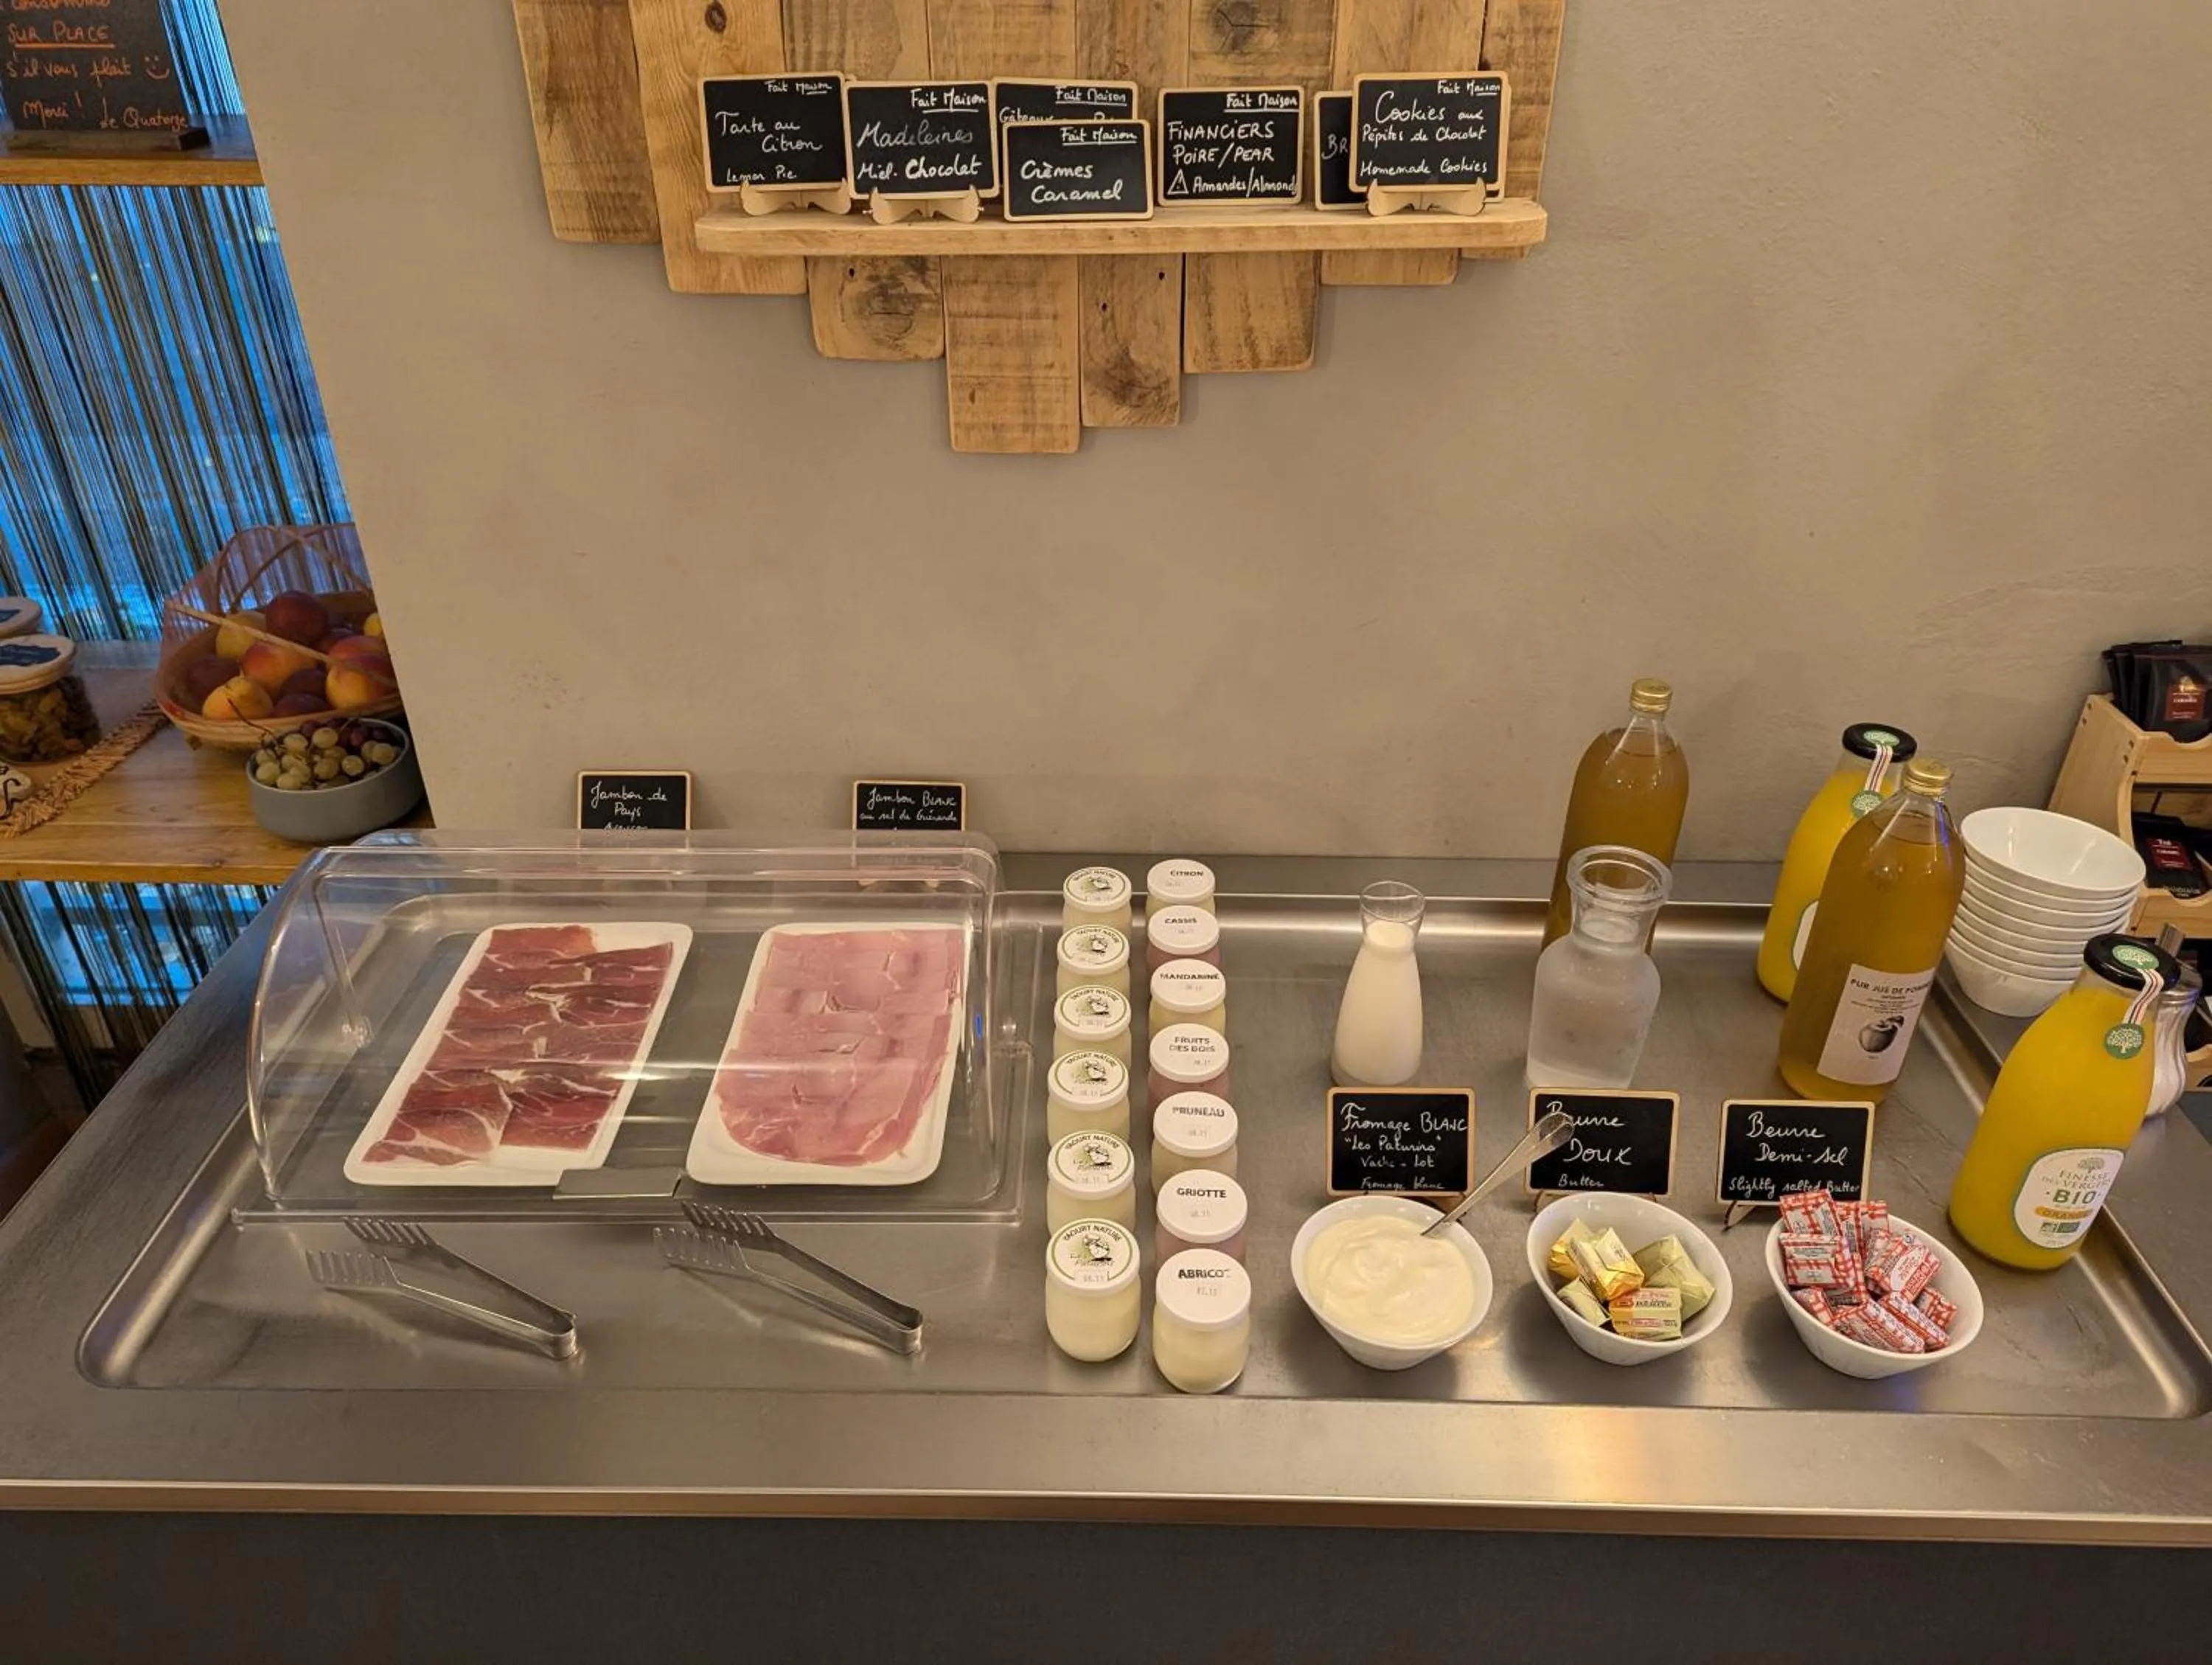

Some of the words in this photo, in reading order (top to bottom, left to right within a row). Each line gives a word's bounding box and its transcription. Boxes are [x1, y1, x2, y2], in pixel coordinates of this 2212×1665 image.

[52, 19, 110, 43] PLACE
[910, 87, 937, 109] Fait
[943, 88, 987, 111] Maison
[1054, 86, 1082, 101] Fait
[1087, 88, 1127, 103] Maison
[1437, 80, 1460, 95] Fait
[1467, 80, 1501, 97] Maison
[1225, 93, 1252, 109] Fait
[1258, 92, 1298, 111] Maison
[1374, 90, 1446, 124] Cookies
[1457, 108, 1484, 121] aux
[122, 106, 189, 133] Quatorze
[714, 110, 766, 136] Tarte
[774, 119, 801, 131] au
[762, 134, 824, 153] Citron
[855, 119, 974, 149] Madeleines
[1060, 126, 1088, 142] Fait
[1092, 125, 1138, 145] Maison
[1362, 124, 1404, 149] Pépites
[1410, 128, 1429, 142] de
[1435, 124, 1487, 142] Chocolat
[904, 153, 984, 181] Chocolat
[1020, 159, 1094, 180] Crèmes
[1359, 159, 1432, 178] Homemade
[1439, 156, 1489, 174] Cookies
[1030, 178, 1124, 204] Caramel
[590, 779, 644, 810] Jambon
[647, 786, 668, 802] de
[866, 786, 917, 810] Jambon
[613, 802, 641, 822] Pays
[1160, 972, 1220, 981] MANDARINE
[1175, 1036, 1210, 1044] FRUITS
[1172, 1106, 1225, 1117] PRUNEAU
[1340, 1102, 1411, 1139] Fromage
[1745, 1110, 1826, 1139] Beurre
[1413, 1154, 1435, 1167] Lot
[1557, 1172, 1604, 1187] Butter
[1176, 1187, 1227, 1198] GRIOTTE
[2052, 1189, 2098, 1205] BIO
